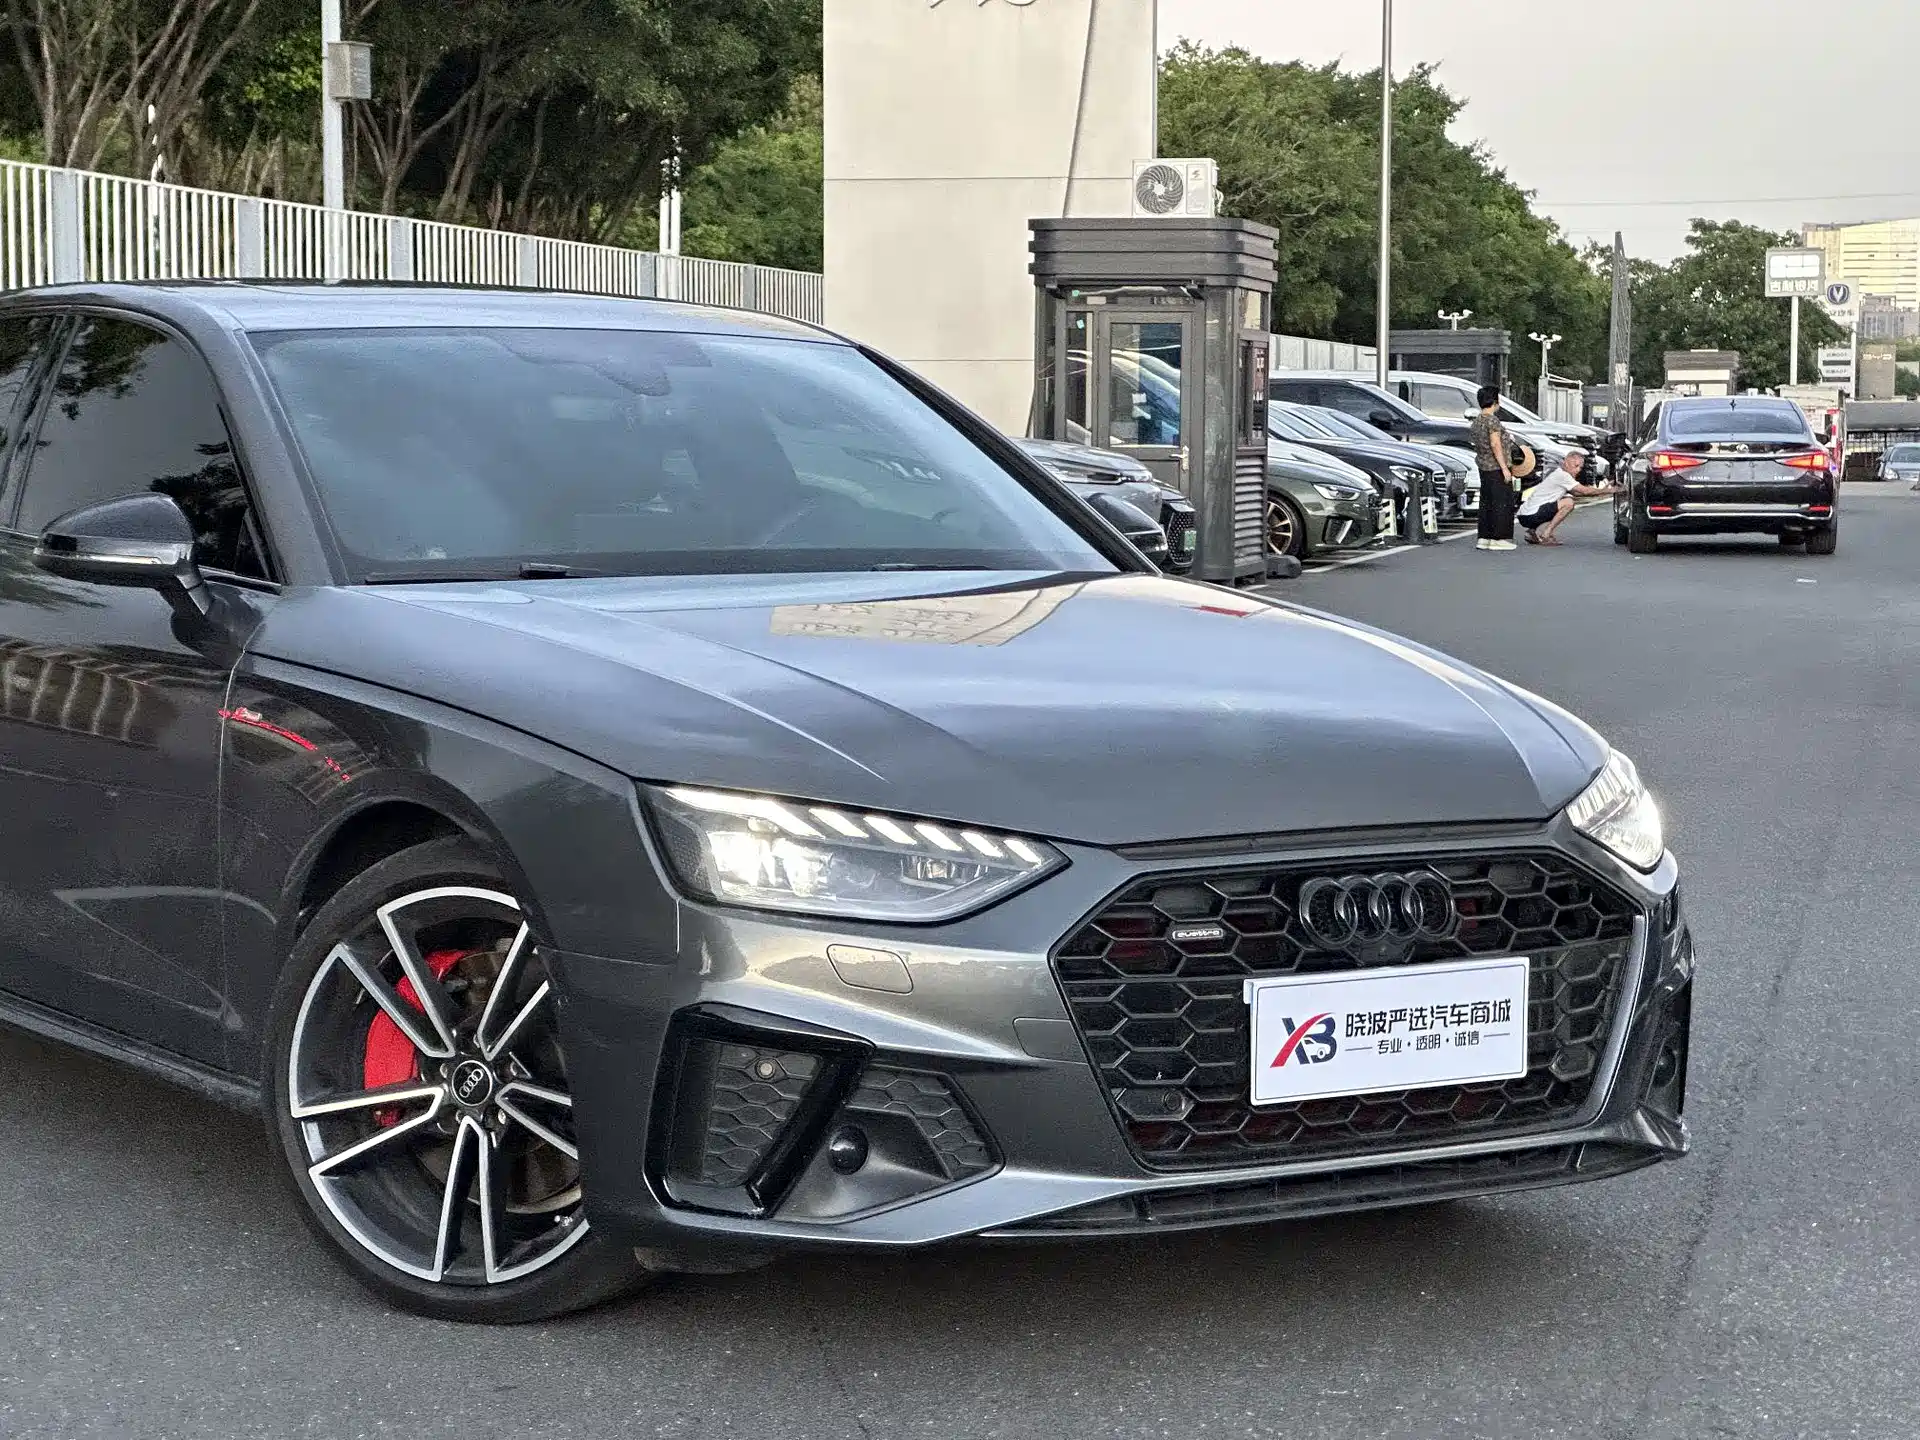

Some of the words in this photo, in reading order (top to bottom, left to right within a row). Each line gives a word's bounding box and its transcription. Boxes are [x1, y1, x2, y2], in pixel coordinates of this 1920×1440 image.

[1345, 999, 1512, 1037] 晓波严选汽车商城
